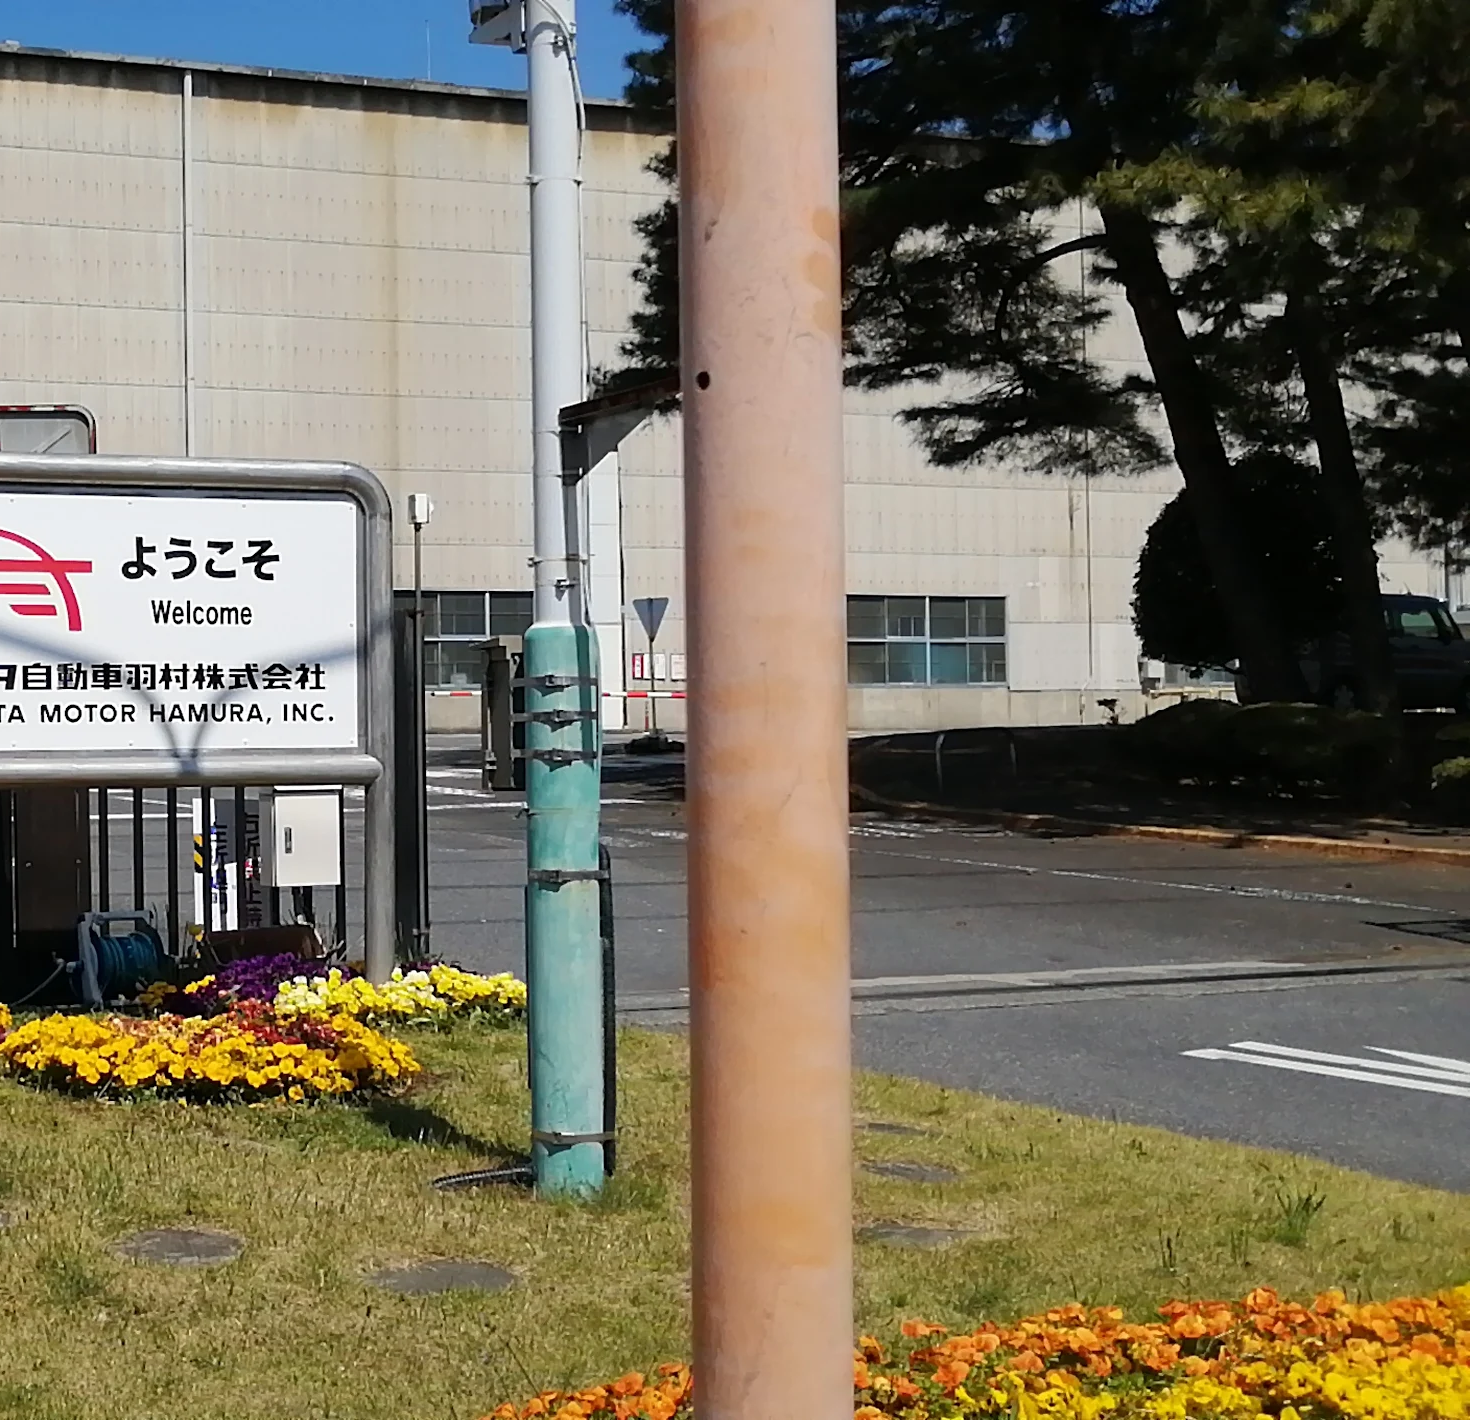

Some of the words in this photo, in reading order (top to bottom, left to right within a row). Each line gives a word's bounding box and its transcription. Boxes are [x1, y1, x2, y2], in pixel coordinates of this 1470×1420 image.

[121, 536, 280, 581] ようこそ
[151, 600, 252, 625] Welcome
[40, 704, 136, 723] MOTOR
[149, 703, 271, 725] HAMURA,
[283, 703, 334, 722] INC.
